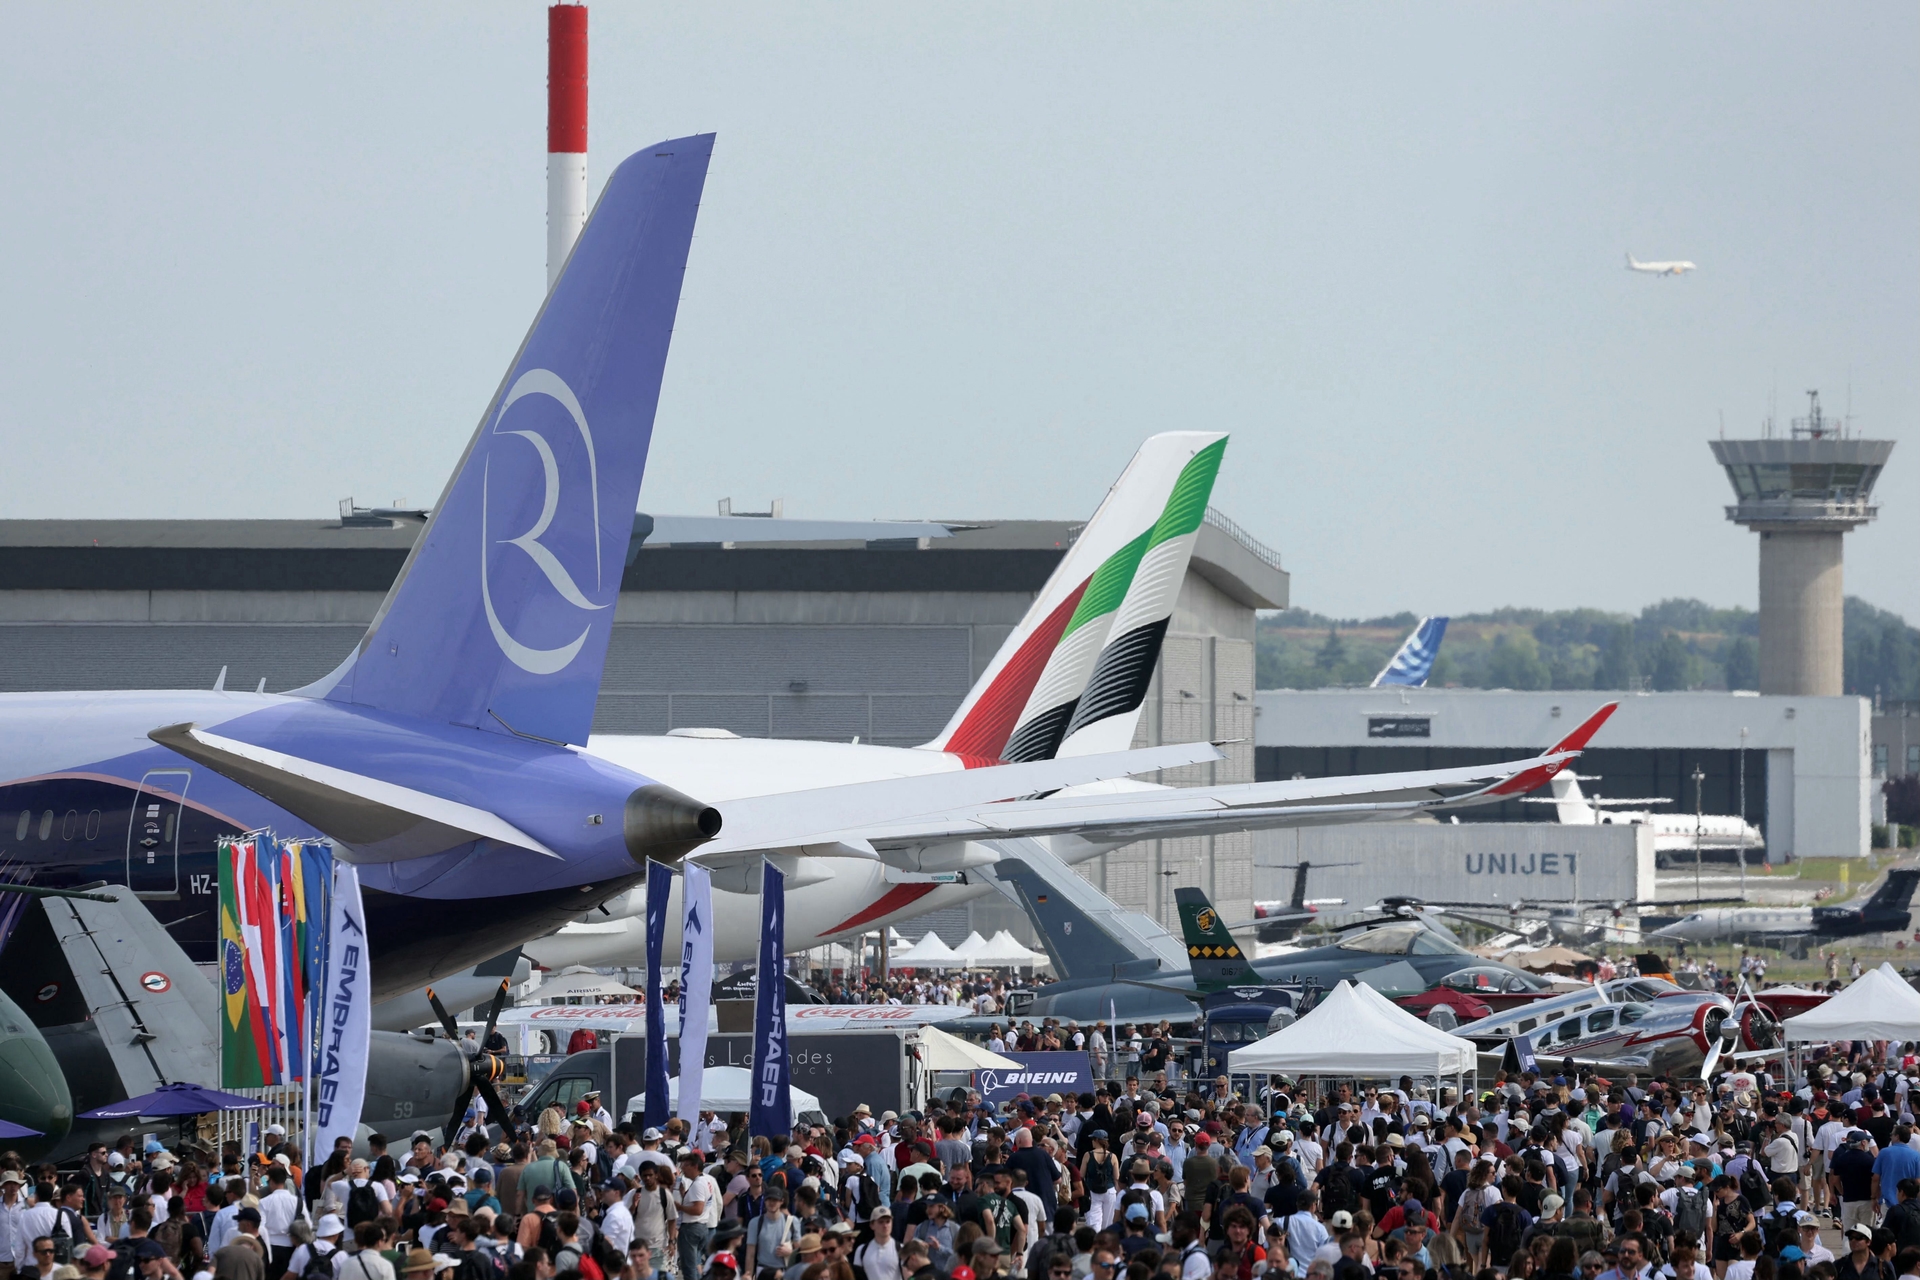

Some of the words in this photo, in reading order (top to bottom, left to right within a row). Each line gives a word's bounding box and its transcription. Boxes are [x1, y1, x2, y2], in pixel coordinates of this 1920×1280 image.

[1465, 852, 1577, 875] UNIJET
[318, 944, 359, 1128] EMBRAER
[1004, 1072, 1078, 1084] BOEING
[393, 1101, 413, 1119] 59
